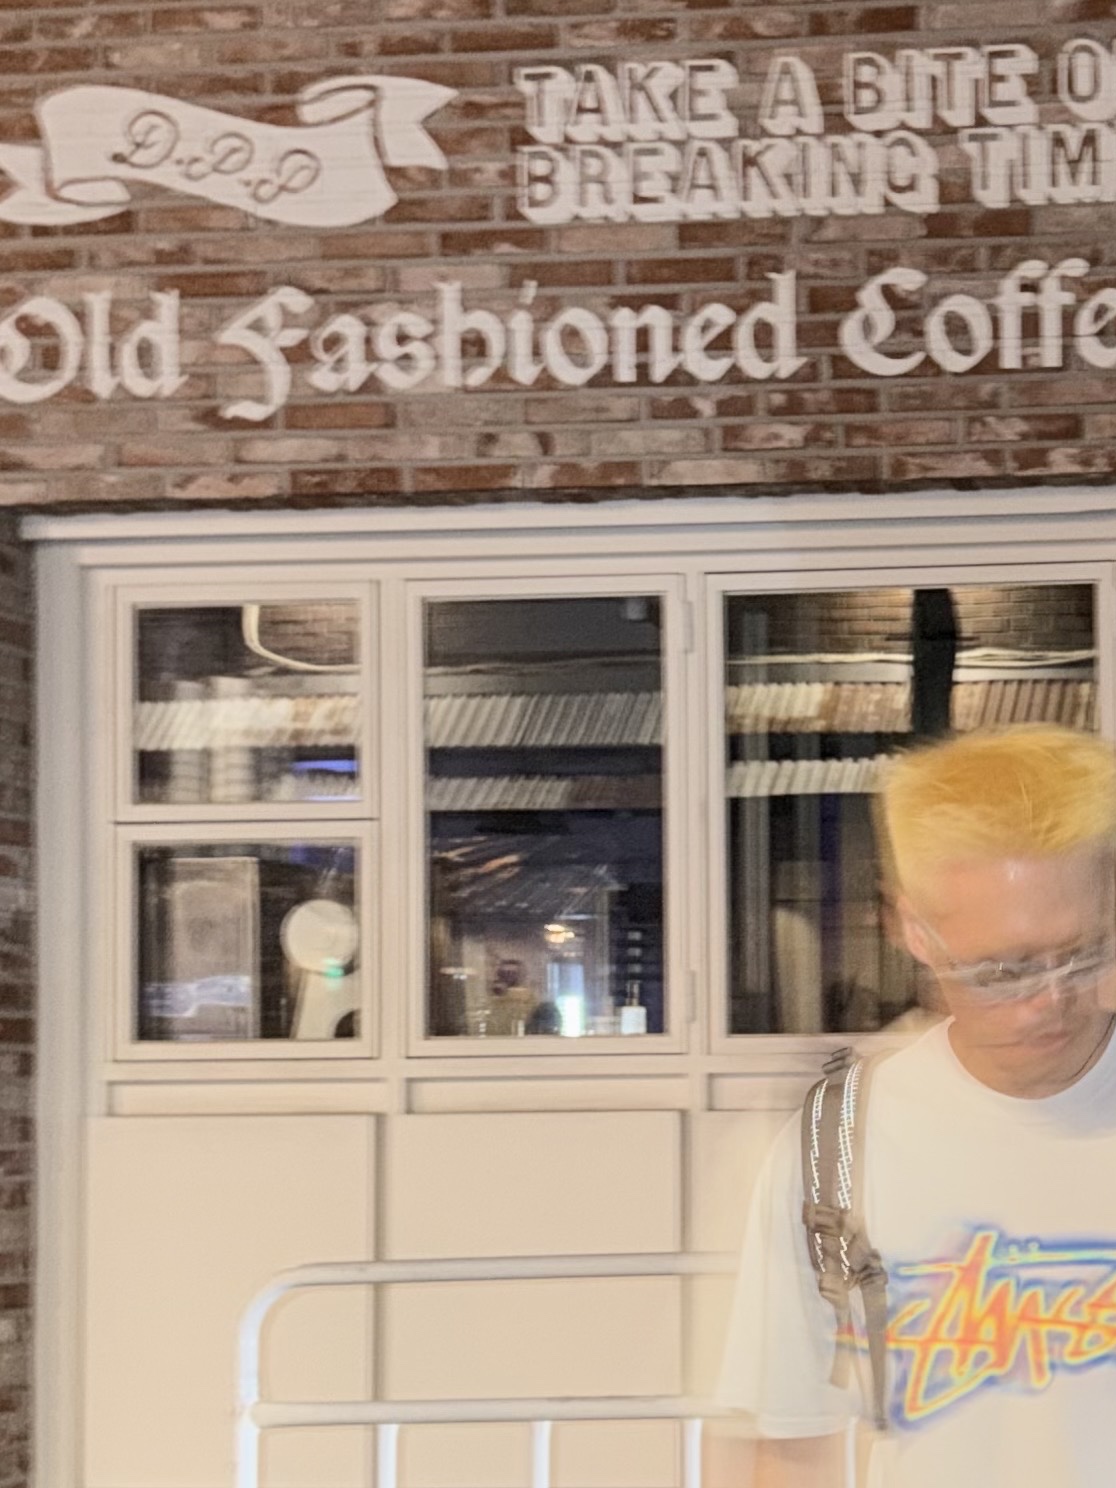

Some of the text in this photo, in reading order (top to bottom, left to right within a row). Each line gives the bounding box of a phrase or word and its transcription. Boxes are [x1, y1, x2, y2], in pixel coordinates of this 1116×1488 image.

[513, 58, 739, 143] TAKE
[757, 56, 825, 136] A
[842, 43, 1039, 131] BITE
[514, 130, 940, 226] BREAKING
[0, 288, 189, 404] Old
[213, 269, 808, 422] Fashioned
